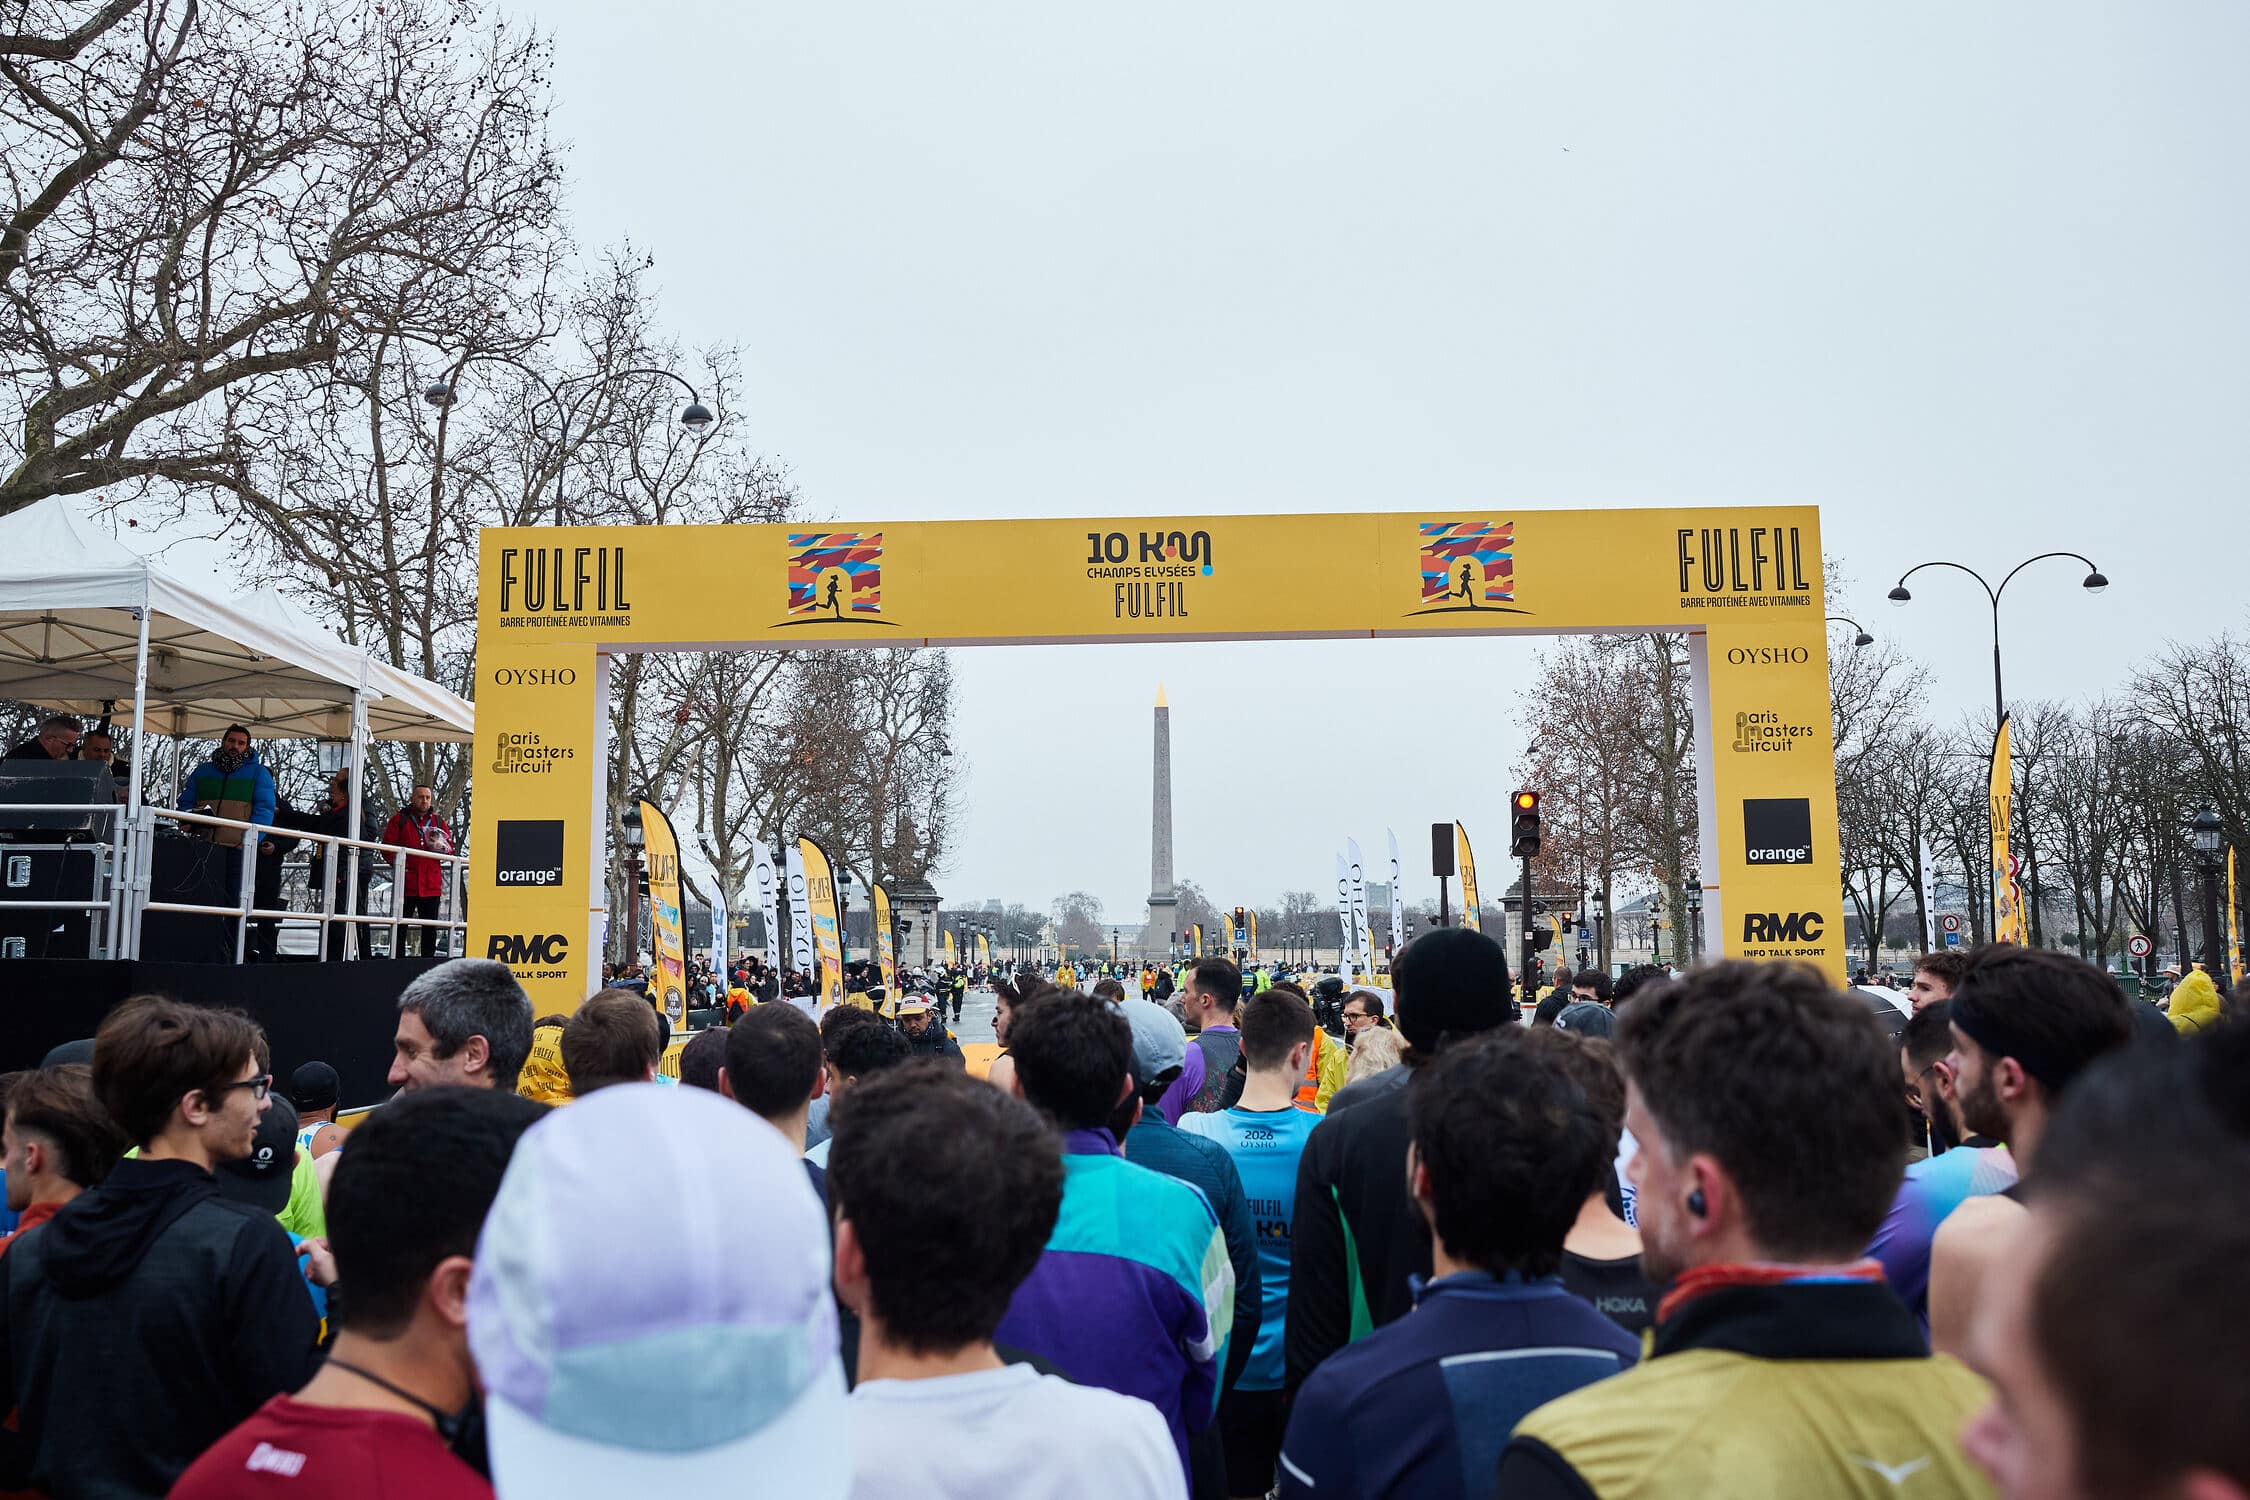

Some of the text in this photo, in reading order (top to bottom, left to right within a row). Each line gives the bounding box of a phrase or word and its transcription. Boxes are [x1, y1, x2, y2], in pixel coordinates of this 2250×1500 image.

[1087, 530, 1213, 577] 10 KM
[1677, 527, 1809, 593] FULFIL
[1087, 563, 1196, 579] CHAMPS ELYSÉES
[500, 547, 630, 612] FULFIL
[1115, 582, 1188, 618] FULFIL
[1680, 594, 1811, 609] BARRE PROTÉINÉE AVEC VITAMINES
[500, 615, 631, 628] BARRE PROTÉINÉE AVEC VITAMINES
[1727, 646, 1809, 665] OYSHO
[494, 668, 576, 686] OYSHO
[1749, 848, 1806, 863] orange
[499, 870, 556, 885] orange
[1743, 911, 1824, 943] RMC
[486, 934, 569, 965] RMC
[1768, 949, 1792, 957] TALK
[1794, 948, 1825, 956] SPORT
[536, 970, 568, 979] SPORT
[1244, 1130, 1274, 1140] 2026
[1240, 1141, 1277, 1149] OYSHO
[1596, 1298, 1647, 1313] HOKA
